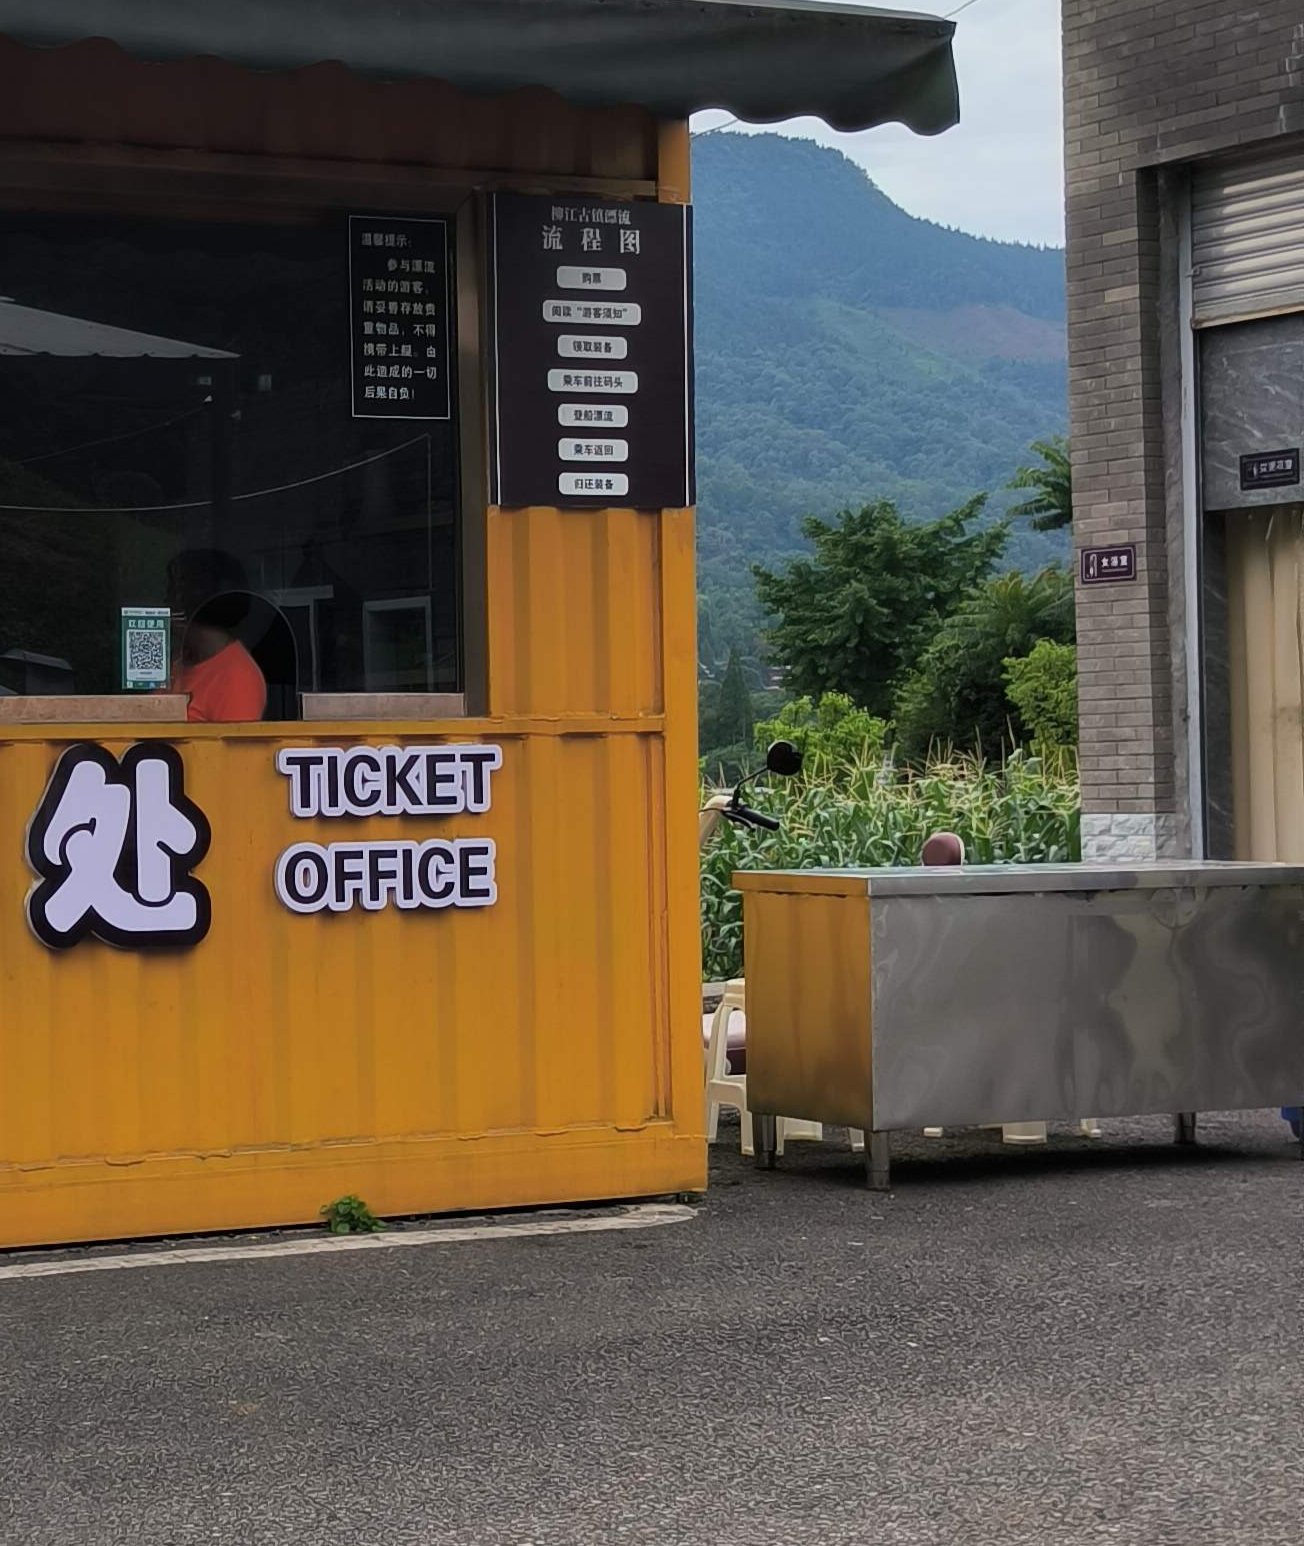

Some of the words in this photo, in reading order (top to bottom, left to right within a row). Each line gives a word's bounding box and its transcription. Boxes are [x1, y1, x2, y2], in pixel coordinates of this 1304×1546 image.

[541, 225, 641, 255] 流程图
[286, 752, 496, 809] TICKET
[284, 846, 490, 905] OFFICE
